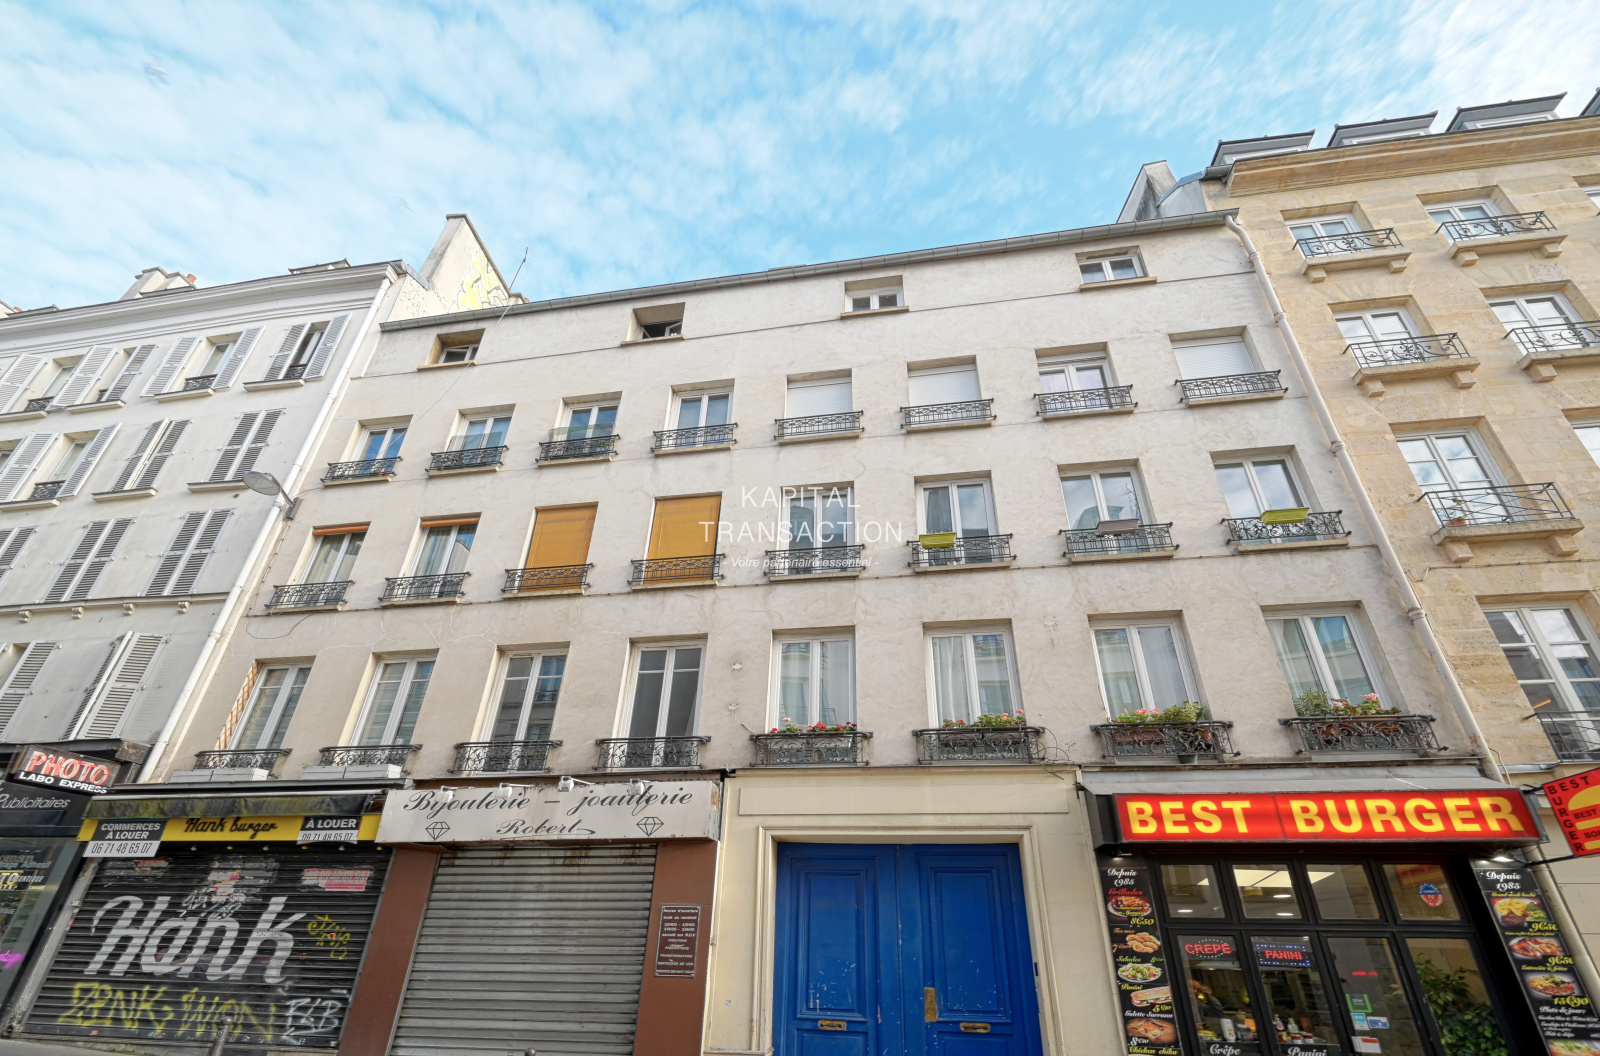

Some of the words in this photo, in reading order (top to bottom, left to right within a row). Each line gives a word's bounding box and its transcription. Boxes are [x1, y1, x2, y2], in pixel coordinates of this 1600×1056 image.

[24, 750, 110, 786] PHOTO
[18, 771, 55, 784] LABO
[59, 779, 108, 794] EXPRESS
[1547, 776, 1589, 796] BEST
[403, 789, 531, 820] Bijouterie
[1126, 799, 1252, 834] BEST
[1289, 796, 1526, 834] BURGER
[1572, 808, 1597, 820] BEST
[101, 823, 161, 832] COMMERCES
[184, 817, 228, 833] Hank
[230, 816, 278, 840] burger
[317, 818, 357, 829] LOUER
[496, 818, 597, 837] Robert
[114, 831, 149, 840] LOUER
[301, 832, 312, 841] 06
[312, 832, 322, 841] 71
[333, 832, 343, 841] 65
[343, 832, 354, 841] 07
[91, 842, 103, 854] 06
[103, 842, 116, 854] 71
[116, 842, 128, 854] 48
[128, 842, 140, 854] 65
[140, 842, 153, 854] 07
[1107, 867, 1137, 879] Depuis
[1485, 870, 1522, 883] Depuis
[1113, 878, 1135, 887] 1985
[1496, 881, 1521, 891] 1985
[1108, 887, 1144, 896] Grillades
[84, 895, 308, 984] Hank
[1184, 943, 1232, 954] CREPE
[1116, 955, 1142, 963] Salades
[1265, 949, 1303, 960] PANINI
[1121, 983, 1144, 991] Panini
[1129, 1046, 1156, 1054] Chicken
[1209, 1043, 1241, 1056] Crêpe
[1287, 1046, 1328, 1056] Panini
